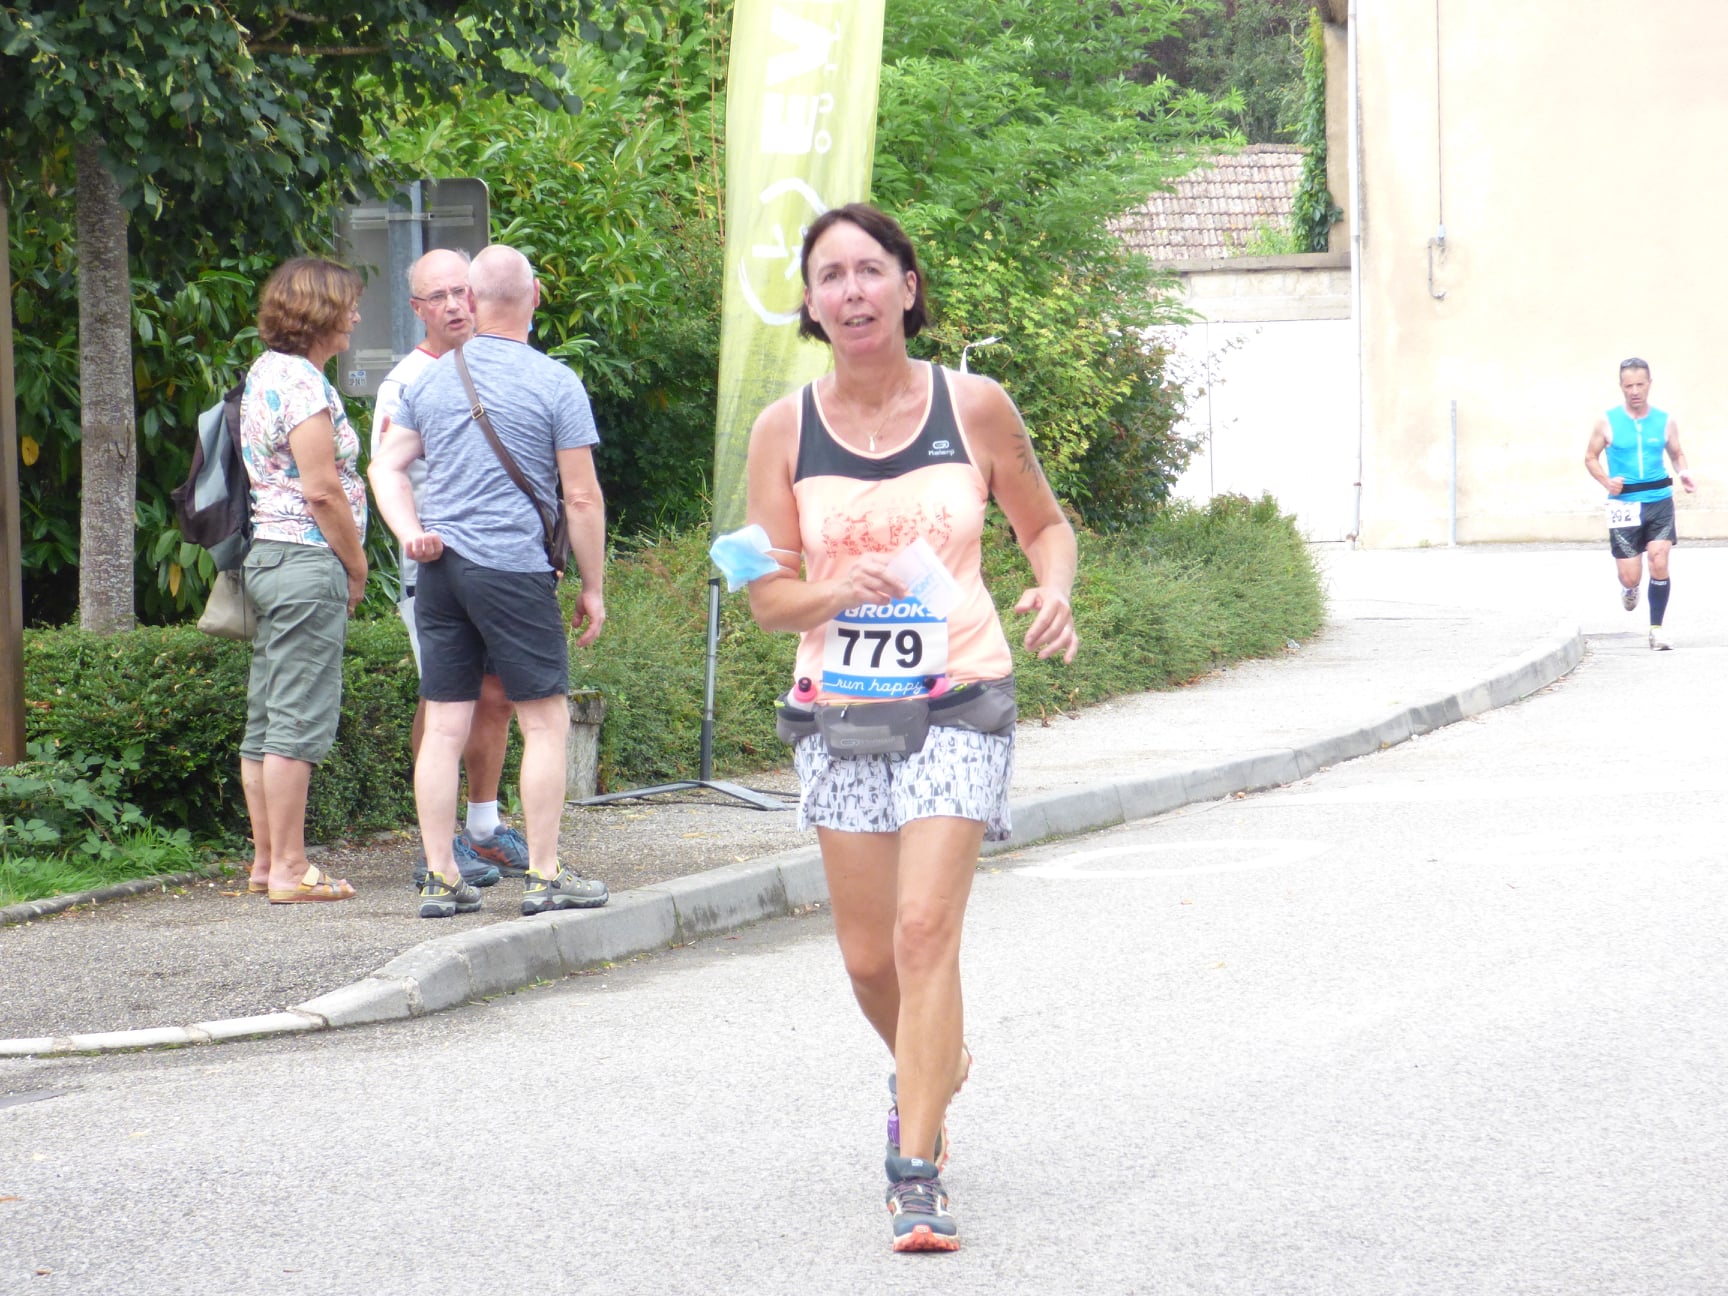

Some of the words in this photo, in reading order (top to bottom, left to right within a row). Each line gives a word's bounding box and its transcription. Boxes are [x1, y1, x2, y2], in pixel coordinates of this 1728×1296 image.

[837, 627, 923, 669] 779
[828, 678, 864, 691] run
[868, 678, 925, 696] happy
